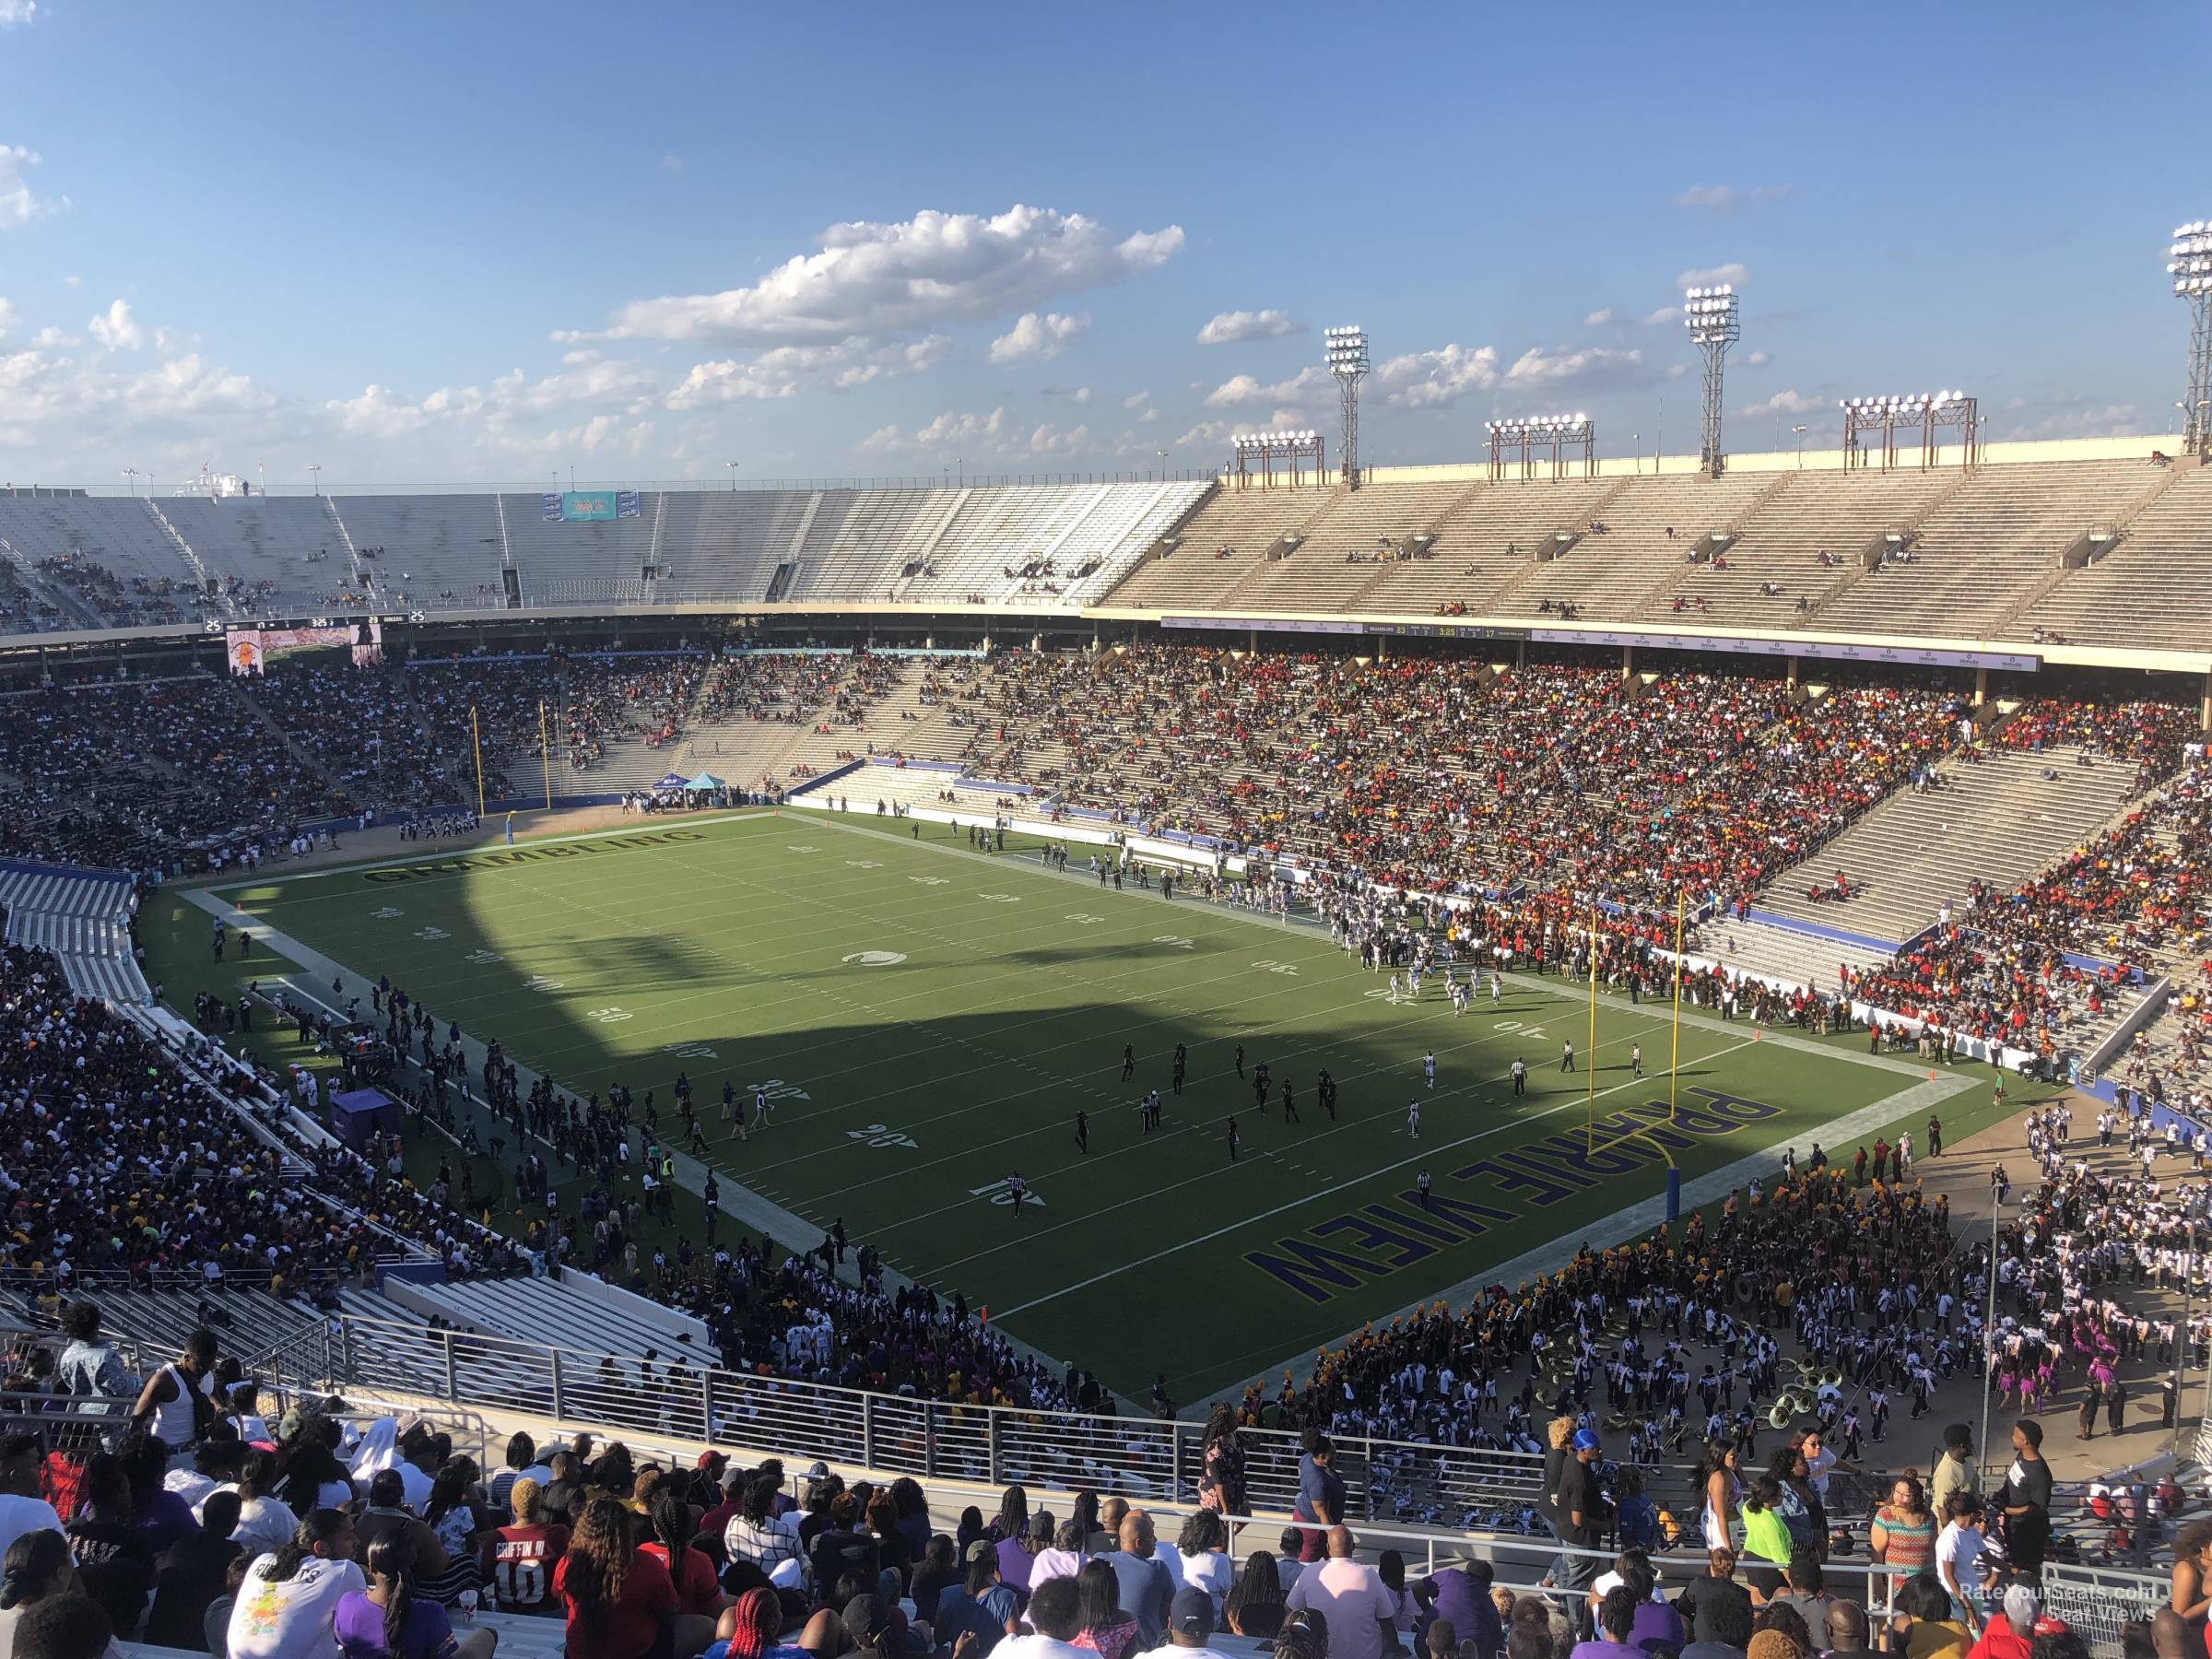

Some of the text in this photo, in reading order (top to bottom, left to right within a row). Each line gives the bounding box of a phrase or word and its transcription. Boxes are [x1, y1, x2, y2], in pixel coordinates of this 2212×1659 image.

[369, 616, 379, 624] 23
[411, 610, 425, 622] 25
[206, 620, 221, 632] 25
[1396, 626, 1406, 635] 23
[1439, 628, 1455, 636] 3:25
[1485, 629, 1495, 638] 17
[361, 831, 708, 884] GRAMBLING
[1064, 913, 1105, 924] 50
[1251, 959, 1299, 974] 30
[587, 1006, 634, 1023] 50
[1493, 1021, 1547, 1037] 10
[747, 1079, 805, 1100] 30
[845, 1124, 908, 1147] 20
[969, 1178, 1032, 1206] 10
[1241, 1085, 1787, 1304] PRAIRIE VIEW
[496, 1539, 546, 1559] GRIFFIN III
[495, 1560, 546, 1605] 10
